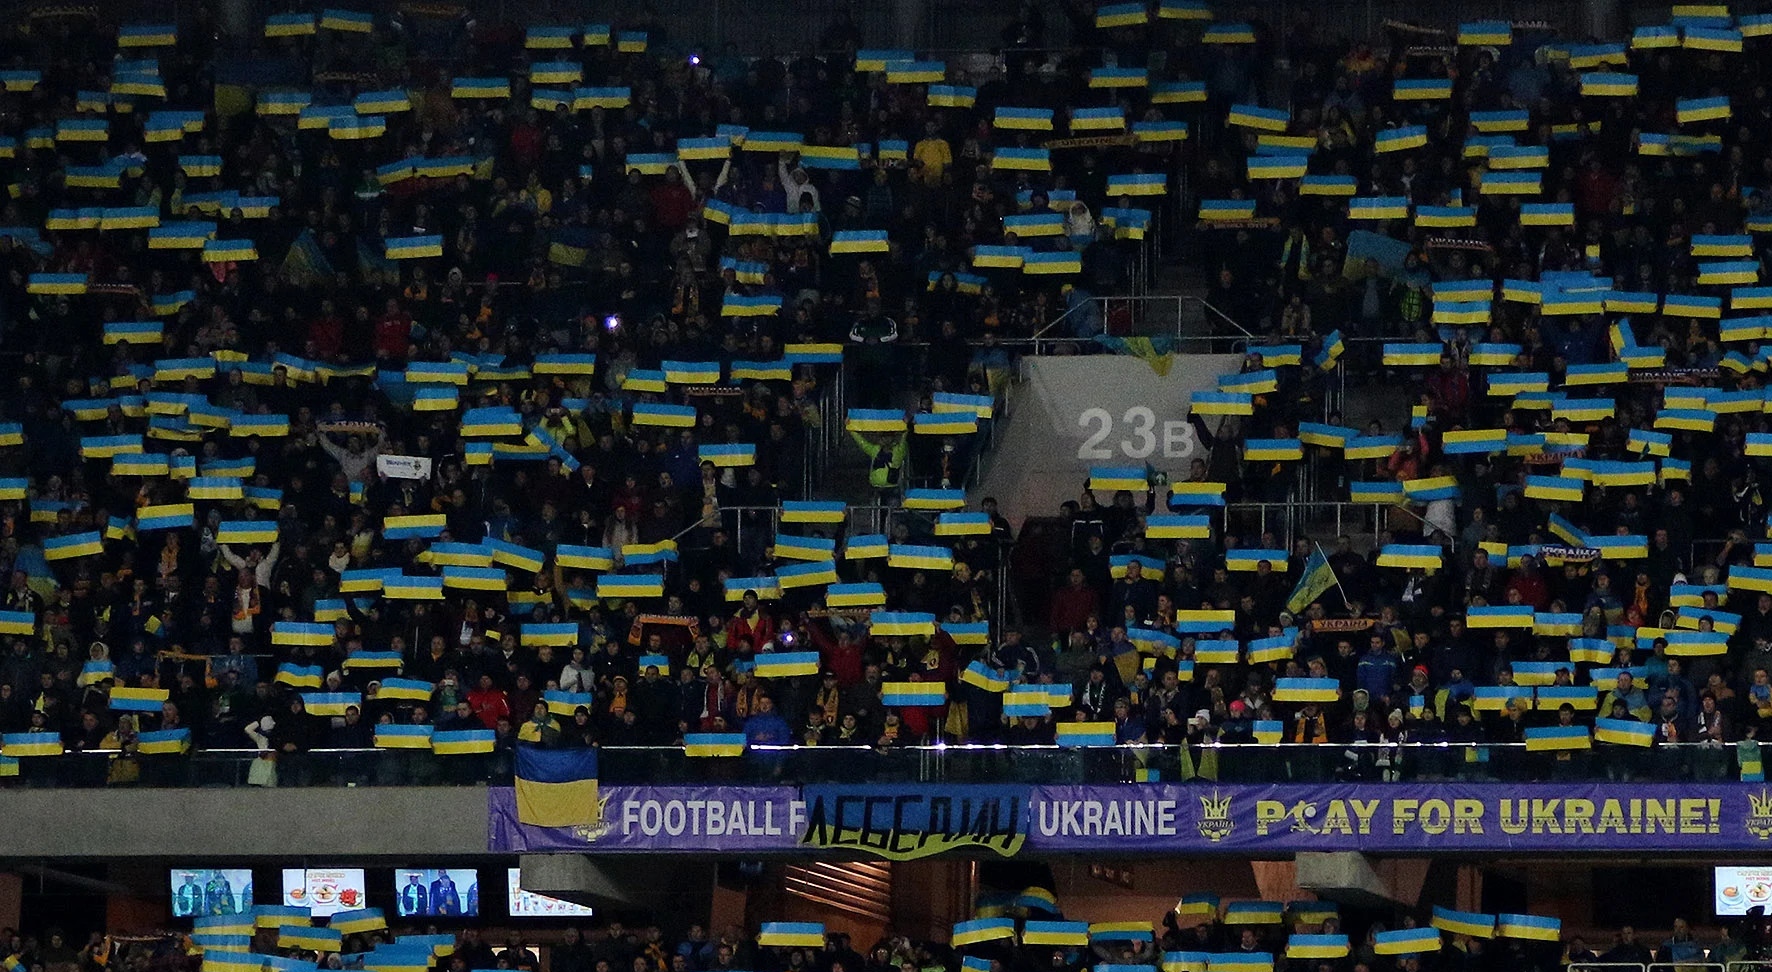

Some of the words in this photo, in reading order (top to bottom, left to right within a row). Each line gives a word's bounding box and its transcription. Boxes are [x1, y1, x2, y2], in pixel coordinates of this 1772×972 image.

[1319, 619, 1368, 630] УКРАЇНА
[622, 800, 781, 837] FOOTBALL
[1038, 799, 1176, 837] UKRAINE
[1198, 820, 1235, 829] УКРАЇНА
[1256, 799, 1380, 836] PLAY
[1392, 799, 1484, 835] FOR
[1498, 798, 1721, 834] UKRAINE!
